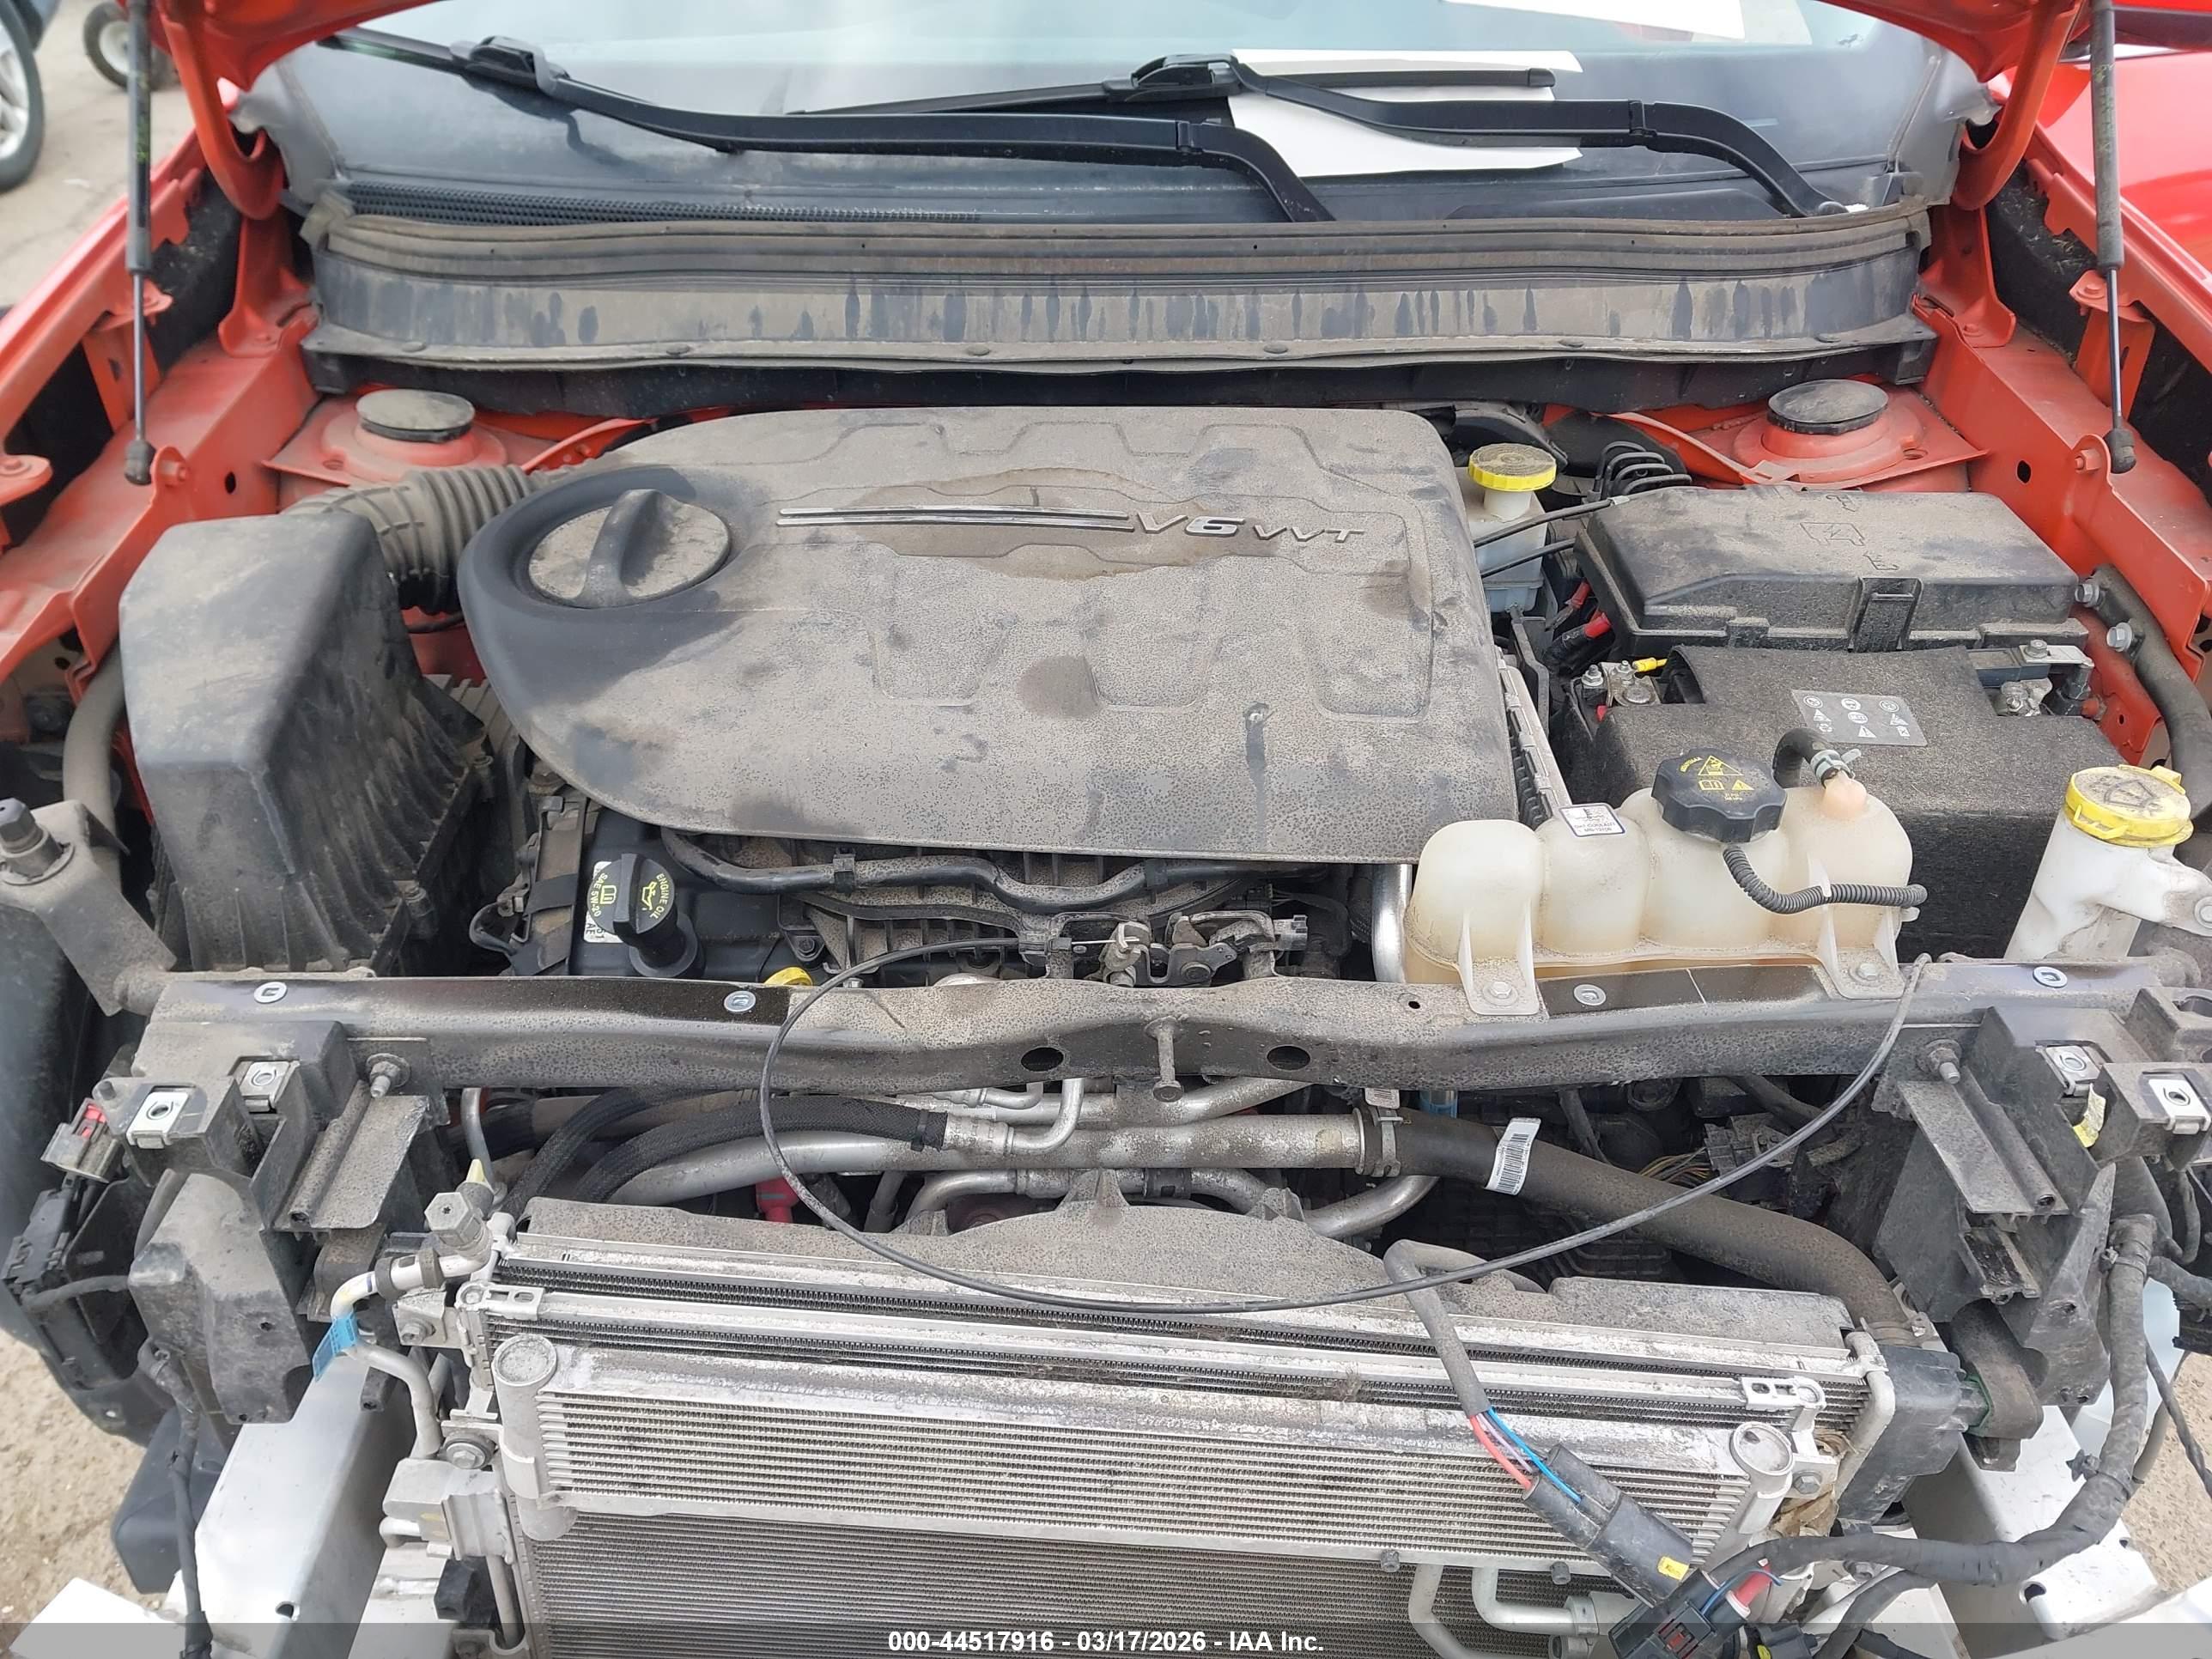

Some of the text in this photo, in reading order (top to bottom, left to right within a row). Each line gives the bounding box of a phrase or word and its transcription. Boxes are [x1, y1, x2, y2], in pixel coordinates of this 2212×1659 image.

[1137, 512, 1364, 544] V6 VVT
[592, 872, 609, 890] SAE
[649, 872, 670, 919] ENGINE OIL
[590, 890, 602, 918] 5W-20
